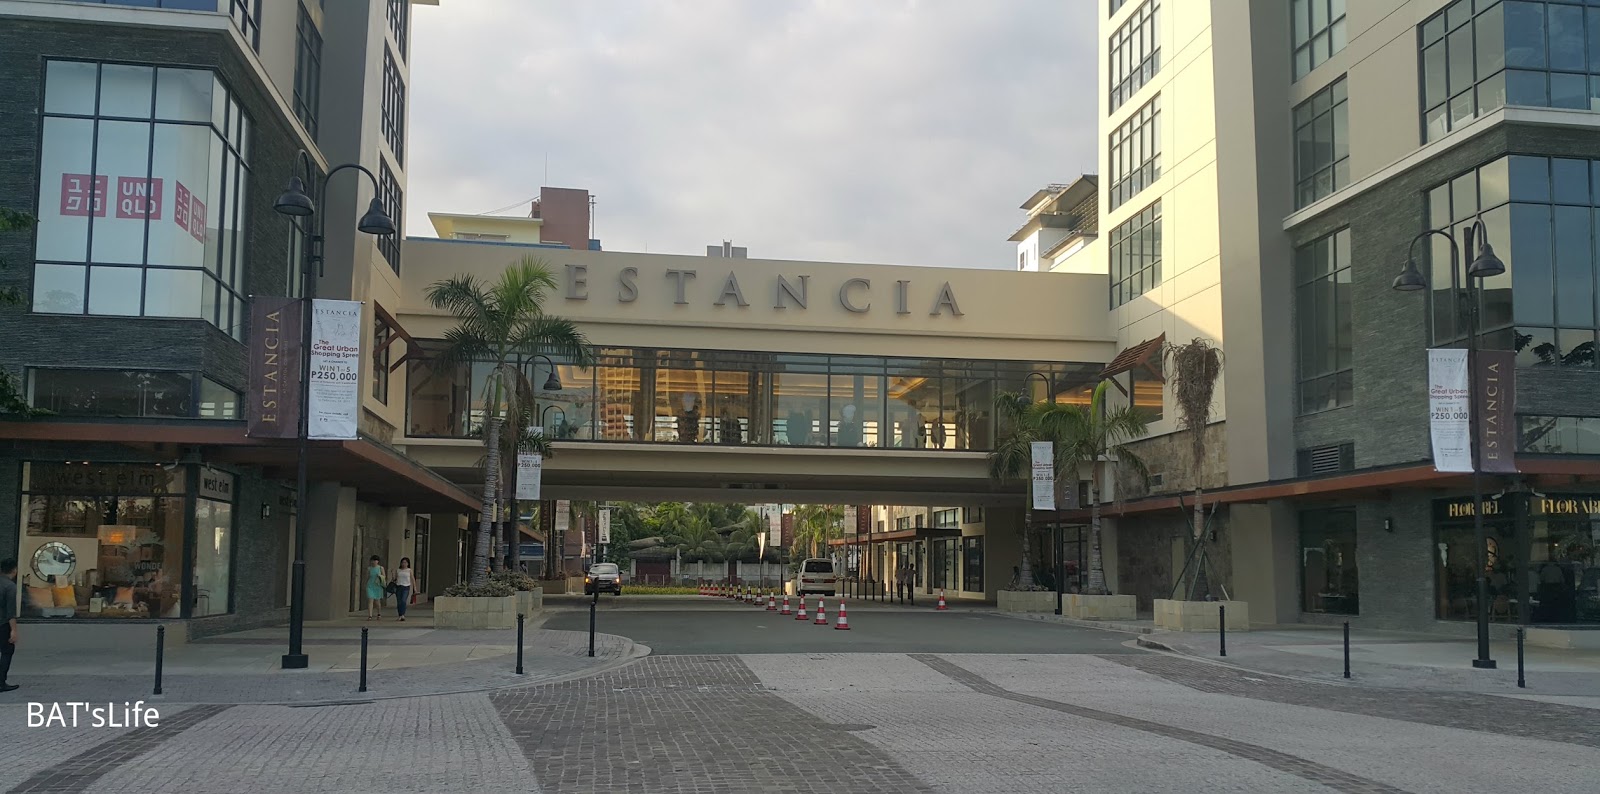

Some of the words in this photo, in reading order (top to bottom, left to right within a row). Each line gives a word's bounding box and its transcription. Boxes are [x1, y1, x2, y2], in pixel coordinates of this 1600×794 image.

[564, 264, 966, 316] ESTANCIA
[315, 308, 358, 317] ESTANCIA
[310, 350, 341, 358] Shopping
[313, 343, 335, 351] Great
[262, 311, 280, 423] ESTANCIA
[1486, 362, 1499, 460] ESTANCIA
[57, 472, 104, 486] west
[117, 470, 155, 486] elm
[203, 477, 218, 490] west
[218, 478, 230, 494] elm
[1449, 500, 1502, 517] FLORBEL
